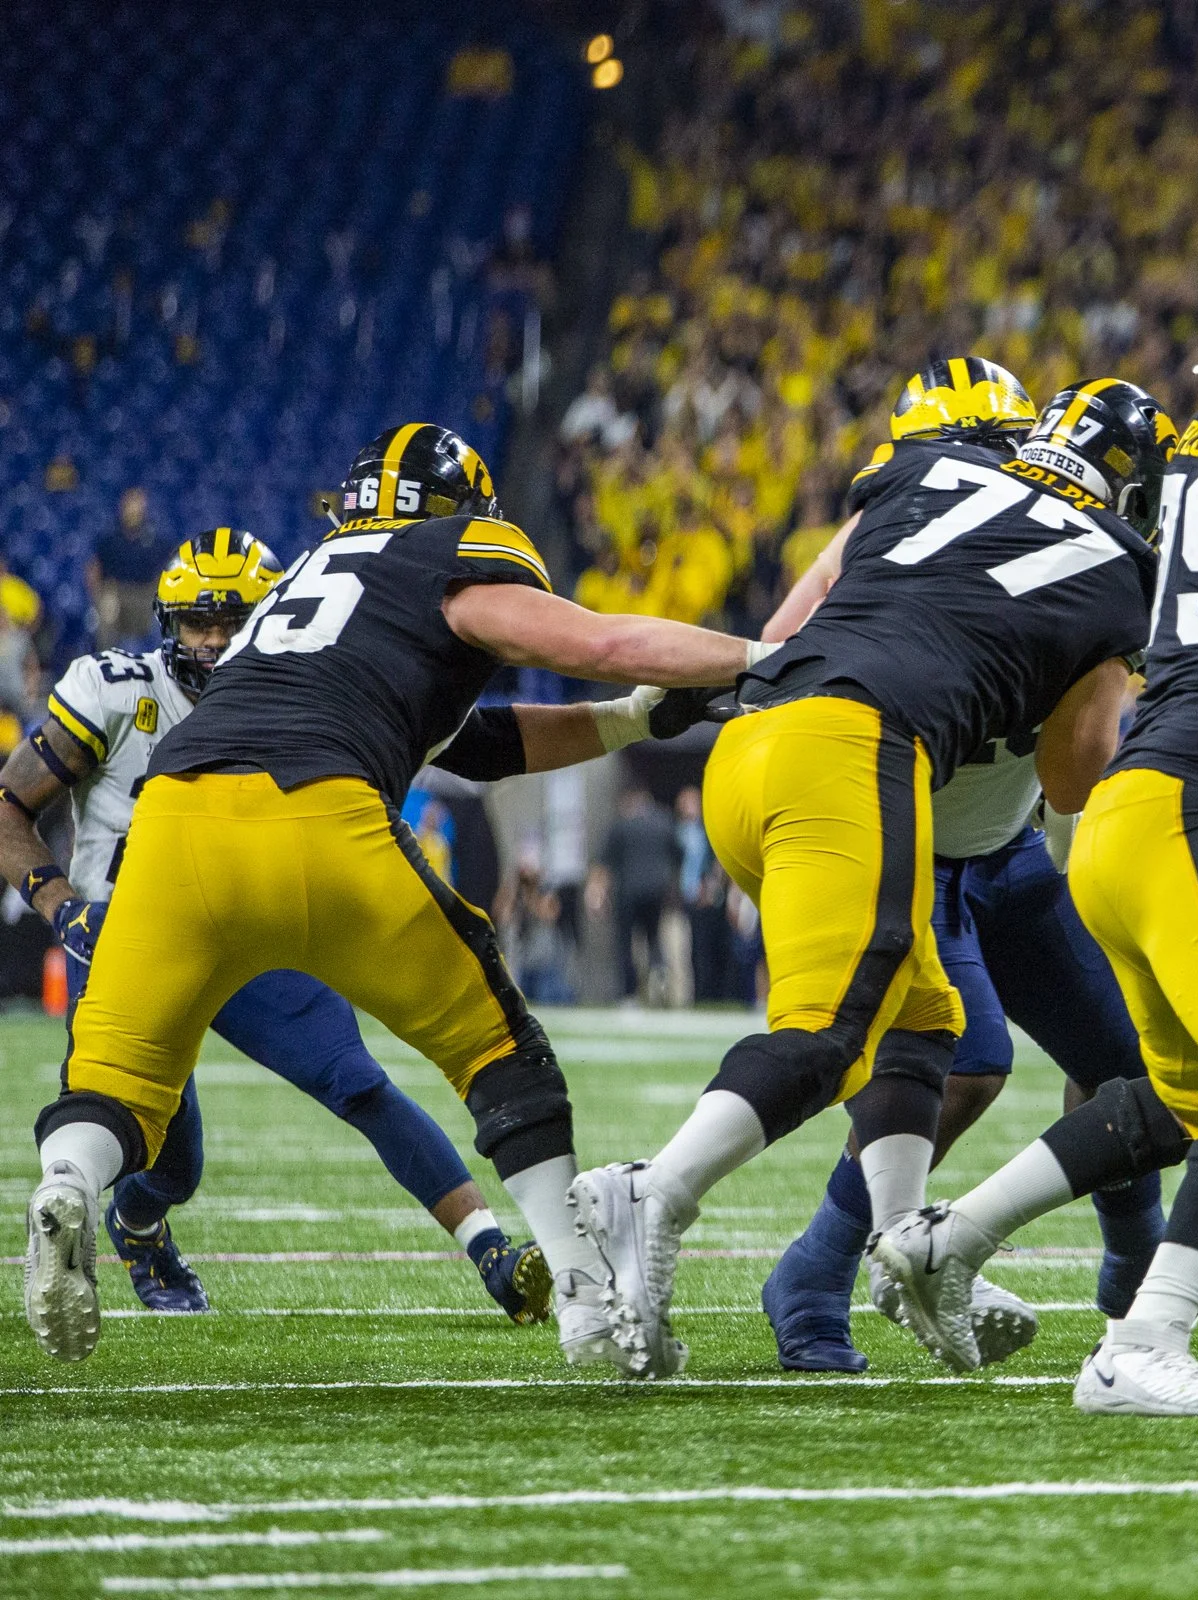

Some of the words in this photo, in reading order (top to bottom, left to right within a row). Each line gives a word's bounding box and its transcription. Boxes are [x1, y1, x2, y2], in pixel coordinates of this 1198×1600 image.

[961, 417, 977, 428] M
[1036, 409, 1104, 446] 77
[1021, 447, 1085, 481] TOGETHER
[360, 478, 421, 513] 65
[1000, 459, 1105, 510] COLBY
[881, 456, 1127, 598] 77
[212, 590, 227, 602] M
